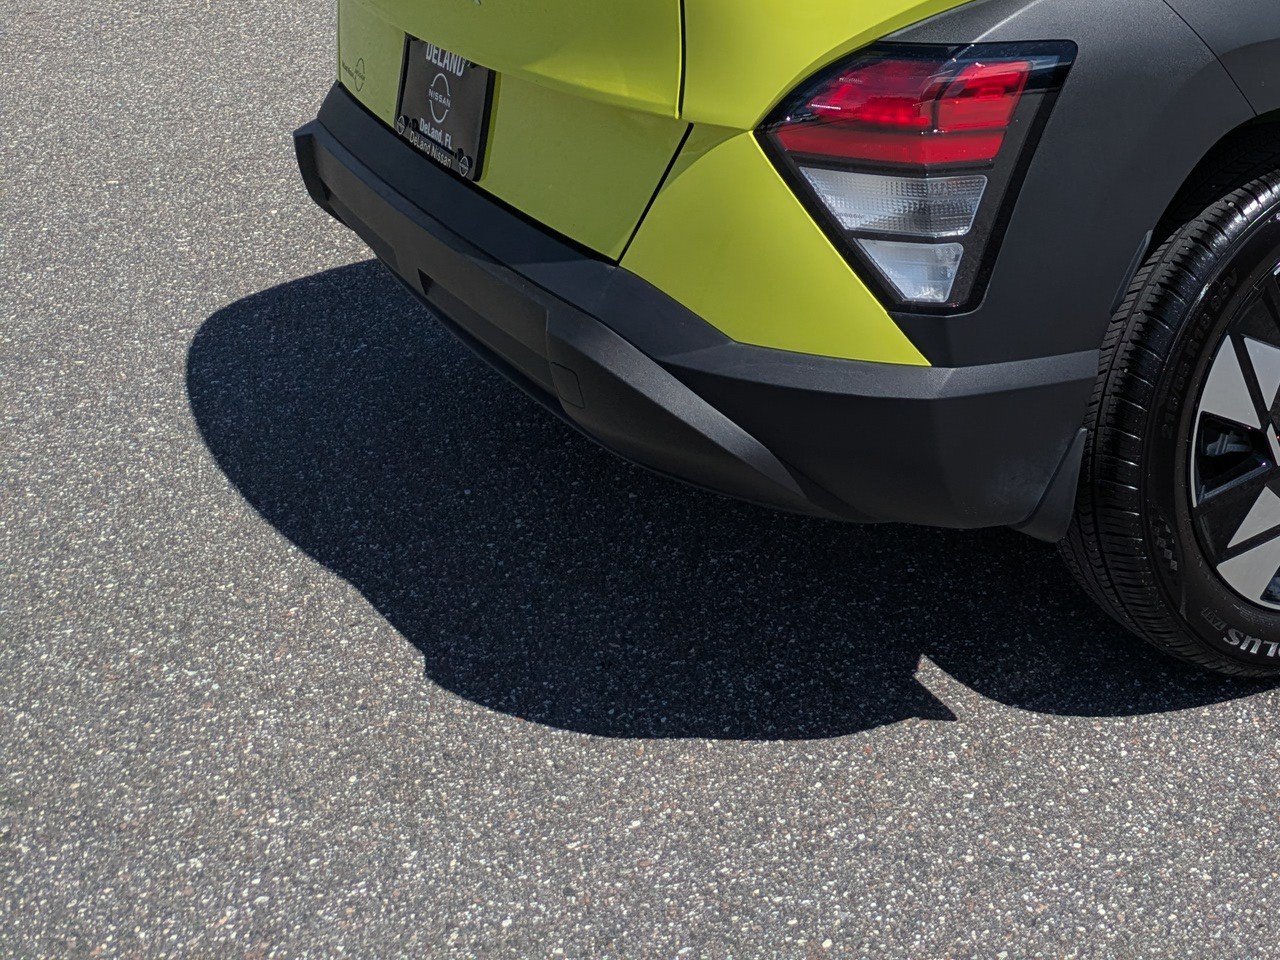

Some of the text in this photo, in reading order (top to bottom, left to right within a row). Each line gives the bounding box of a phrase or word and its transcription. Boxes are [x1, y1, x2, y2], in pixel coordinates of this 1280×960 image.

[425, 43, 465, 78] DELAND
[428, 88, 451, 109] NISSAN
[410, 130, 452, 169] DeLand Nissan
[445, 132, 452, 151] FL
